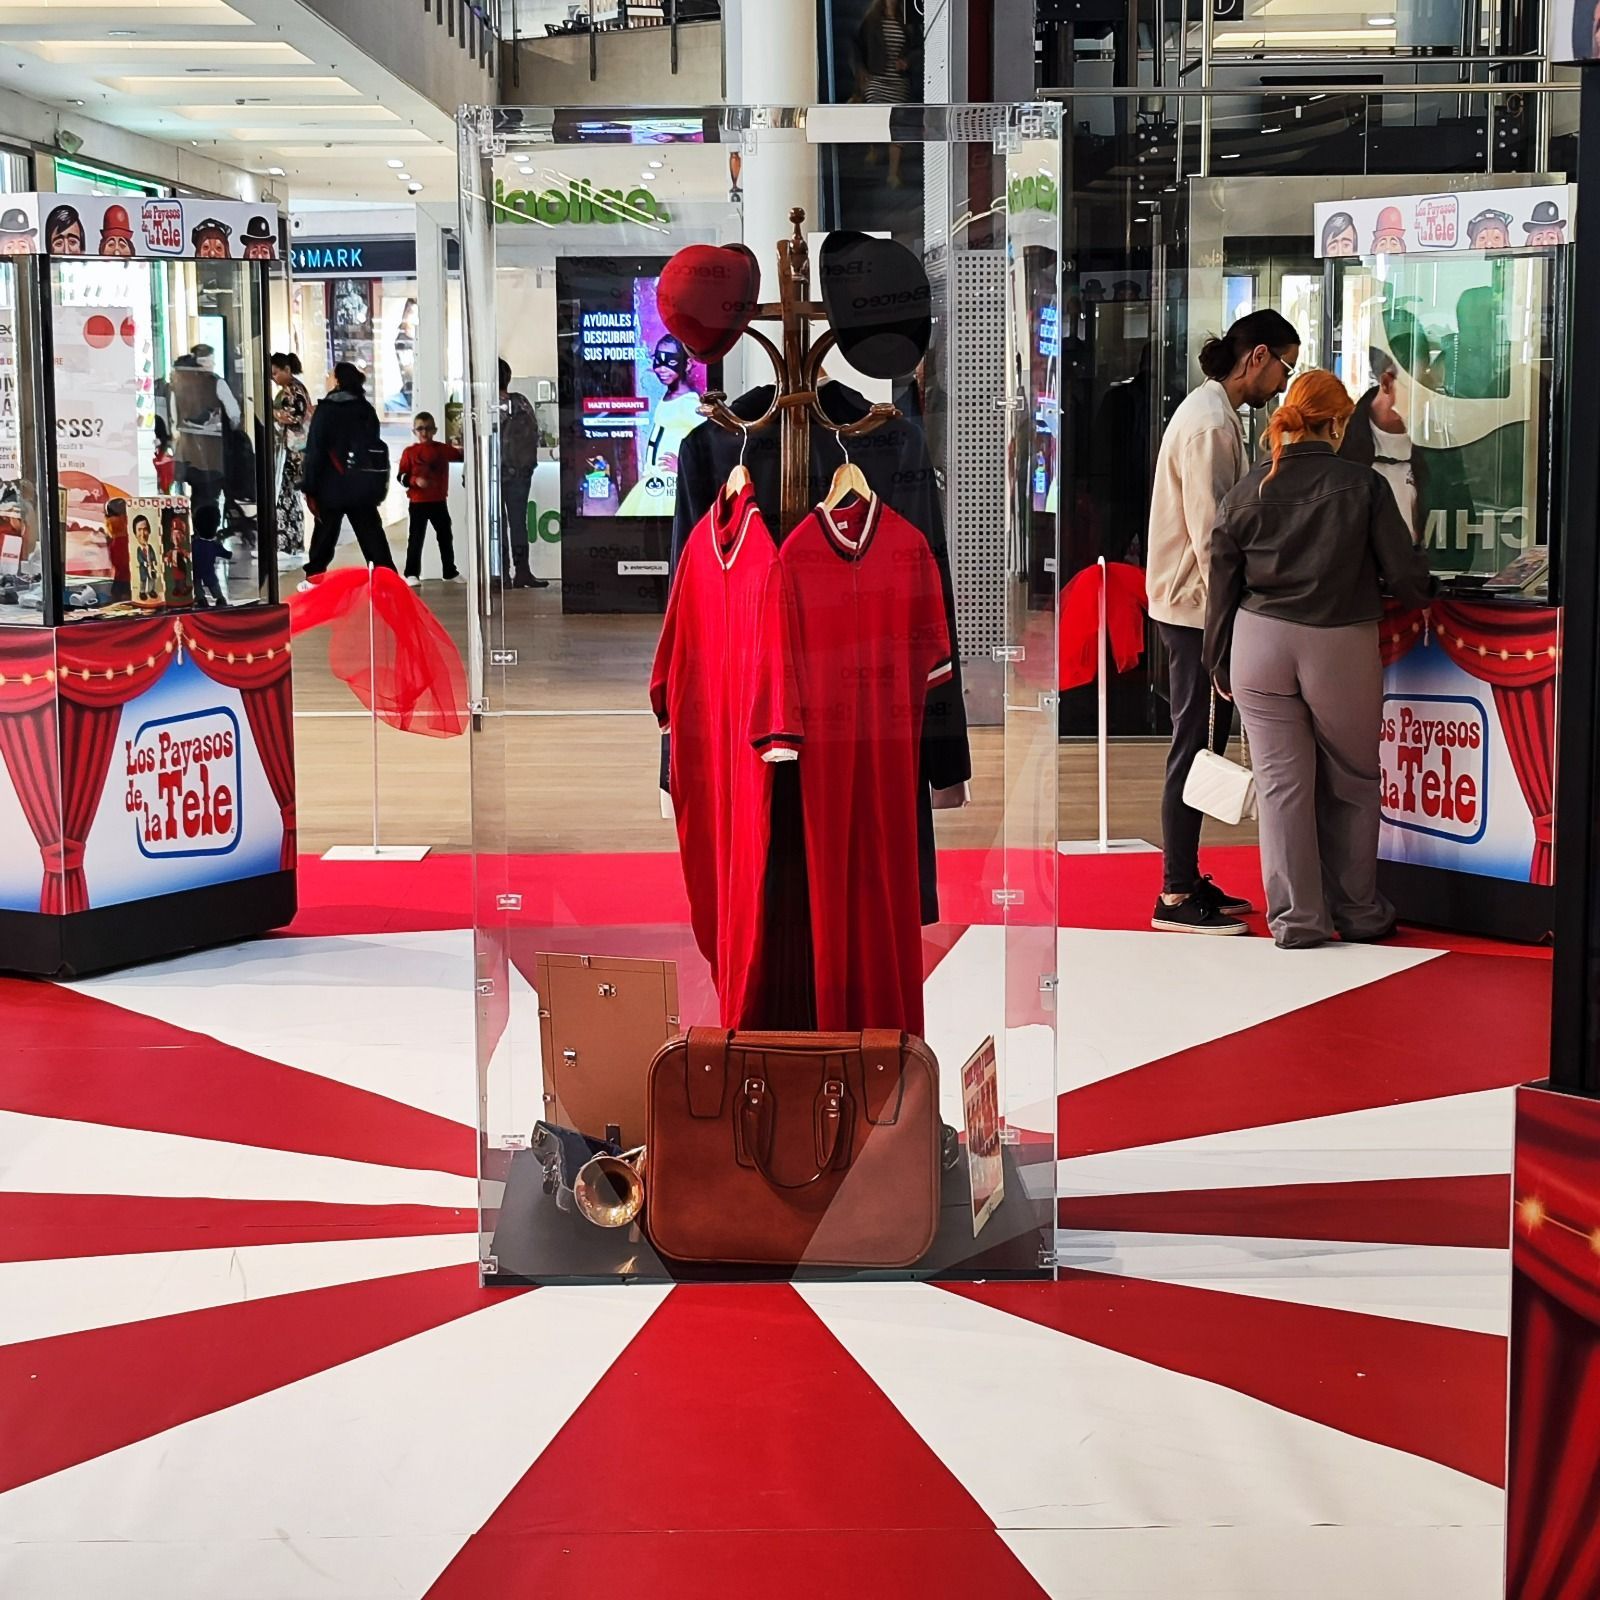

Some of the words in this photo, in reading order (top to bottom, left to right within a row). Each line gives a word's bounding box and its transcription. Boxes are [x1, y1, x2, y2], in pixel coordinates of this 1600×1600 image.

[141, 205, 152, 219] Los
[153, 205, 180, 222] Payasos
[1415, 204, 1426, 217] Los
[1427, 203, 1456, 218] Payasos
[153, 219, 180, 247] Tele
[1427, 215, 1454, 241] Tele
[583, 311, 631, 327] AYÚDALES
[633, 313, 640, 327] A
[583, 330, 635, 344] DESCUBRIR
[584, 347, 602, 360] SUS
[604, 347, 646, 360] PODERES
[1379, 718, 1395, 742] os
[1400, 707, 1480, 755] Payasos
[125, 740, 155, 776] Los
[159, 731, 233, 776] Payasos
[125, 779, 142, 812] de
[1381, 768, 1399, 809] la
[1398, 745, 1476, 824] Tele
[144, 801, 162, 842] la
[158, 763, 232, 840] Tele
